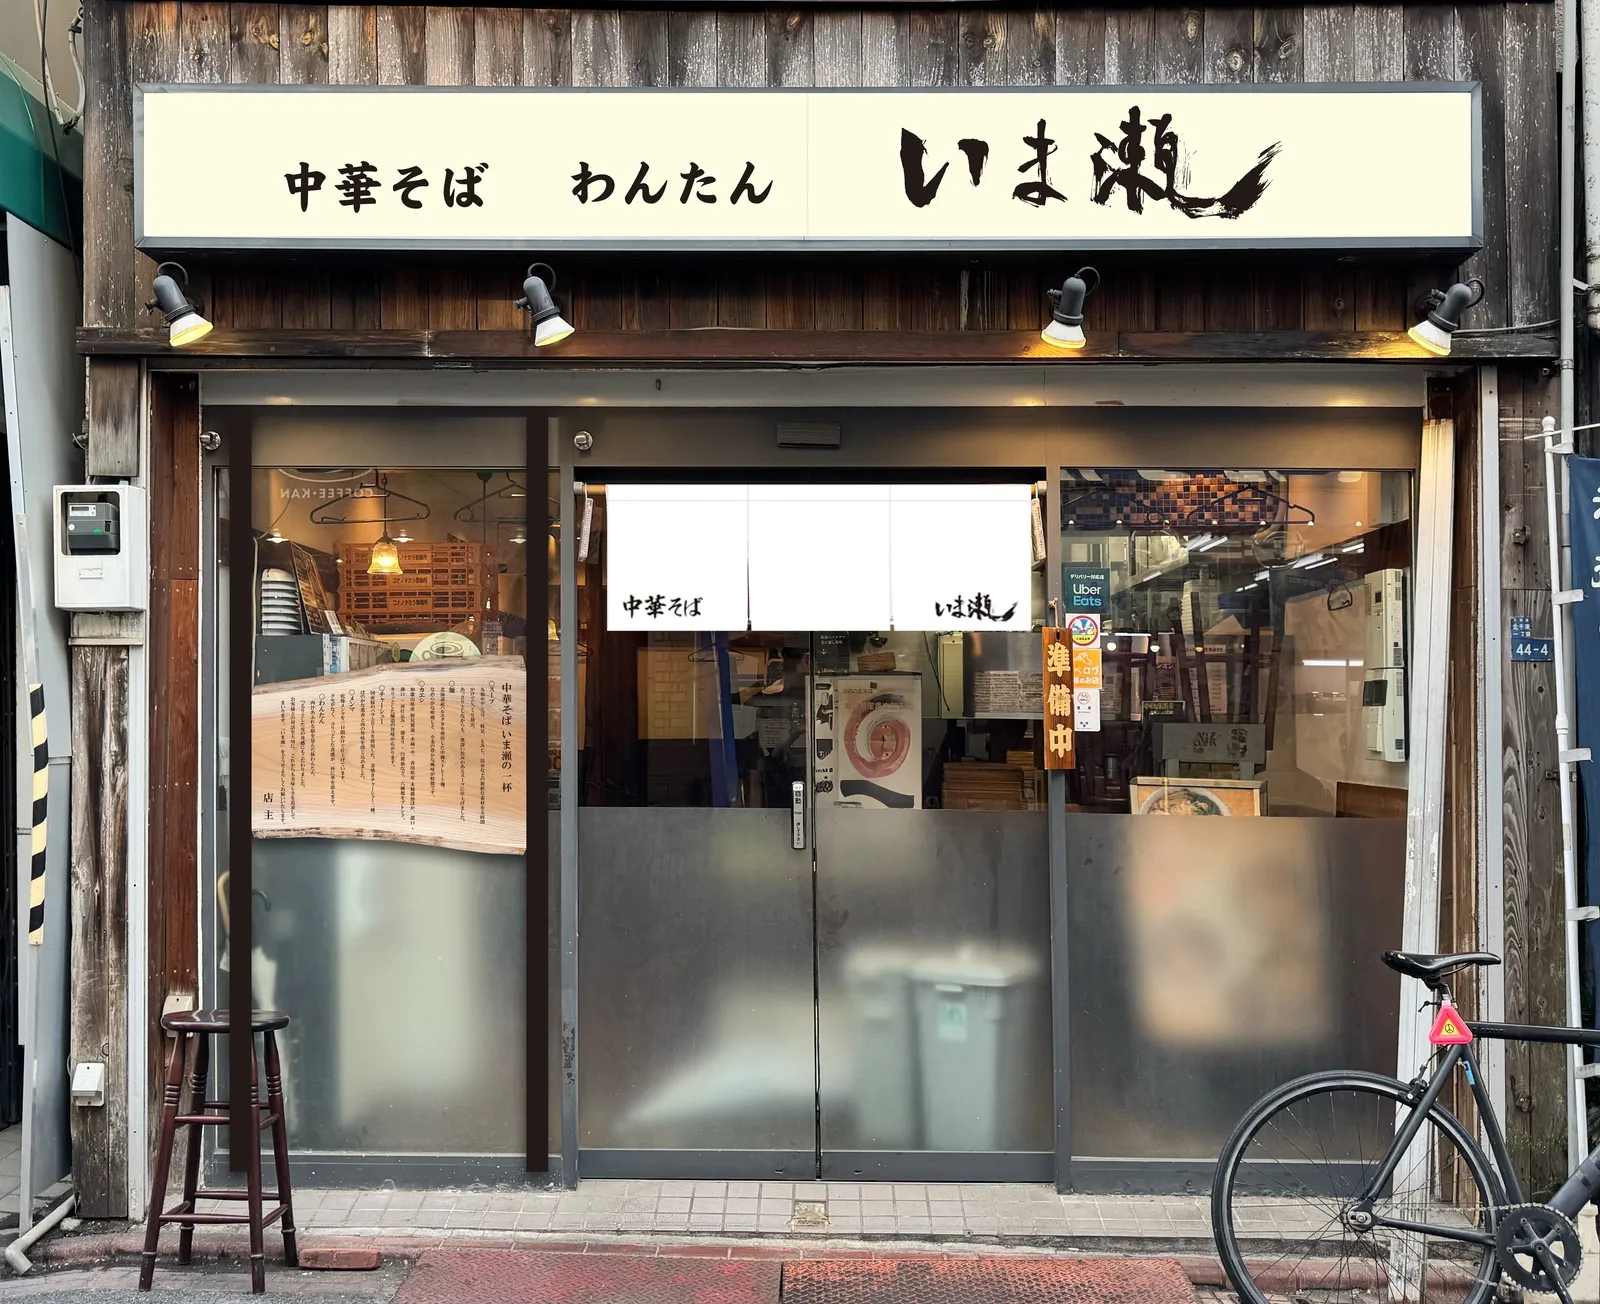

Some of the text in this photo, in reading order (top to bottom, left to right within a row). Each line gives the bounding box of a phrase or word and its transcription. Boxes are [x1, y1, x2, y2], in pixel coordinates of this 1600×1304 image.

[900, 106, 1279, 219] いま瀬
[284, 161, 773, 213] 中華そば わんたん
[1073, 583, 1102, 595] Uber
[1073, 595, 1102, 606] Eats
[623, 595, 702, 618] 中華そば
[936, 593, 1016, 621] いま瀬
[1516, 643, 1549, 656] 44-4
[1047, 642, 1073, 759] 準備中
[501, 682, 513, 793] 中華そば いま瀬の一杯
